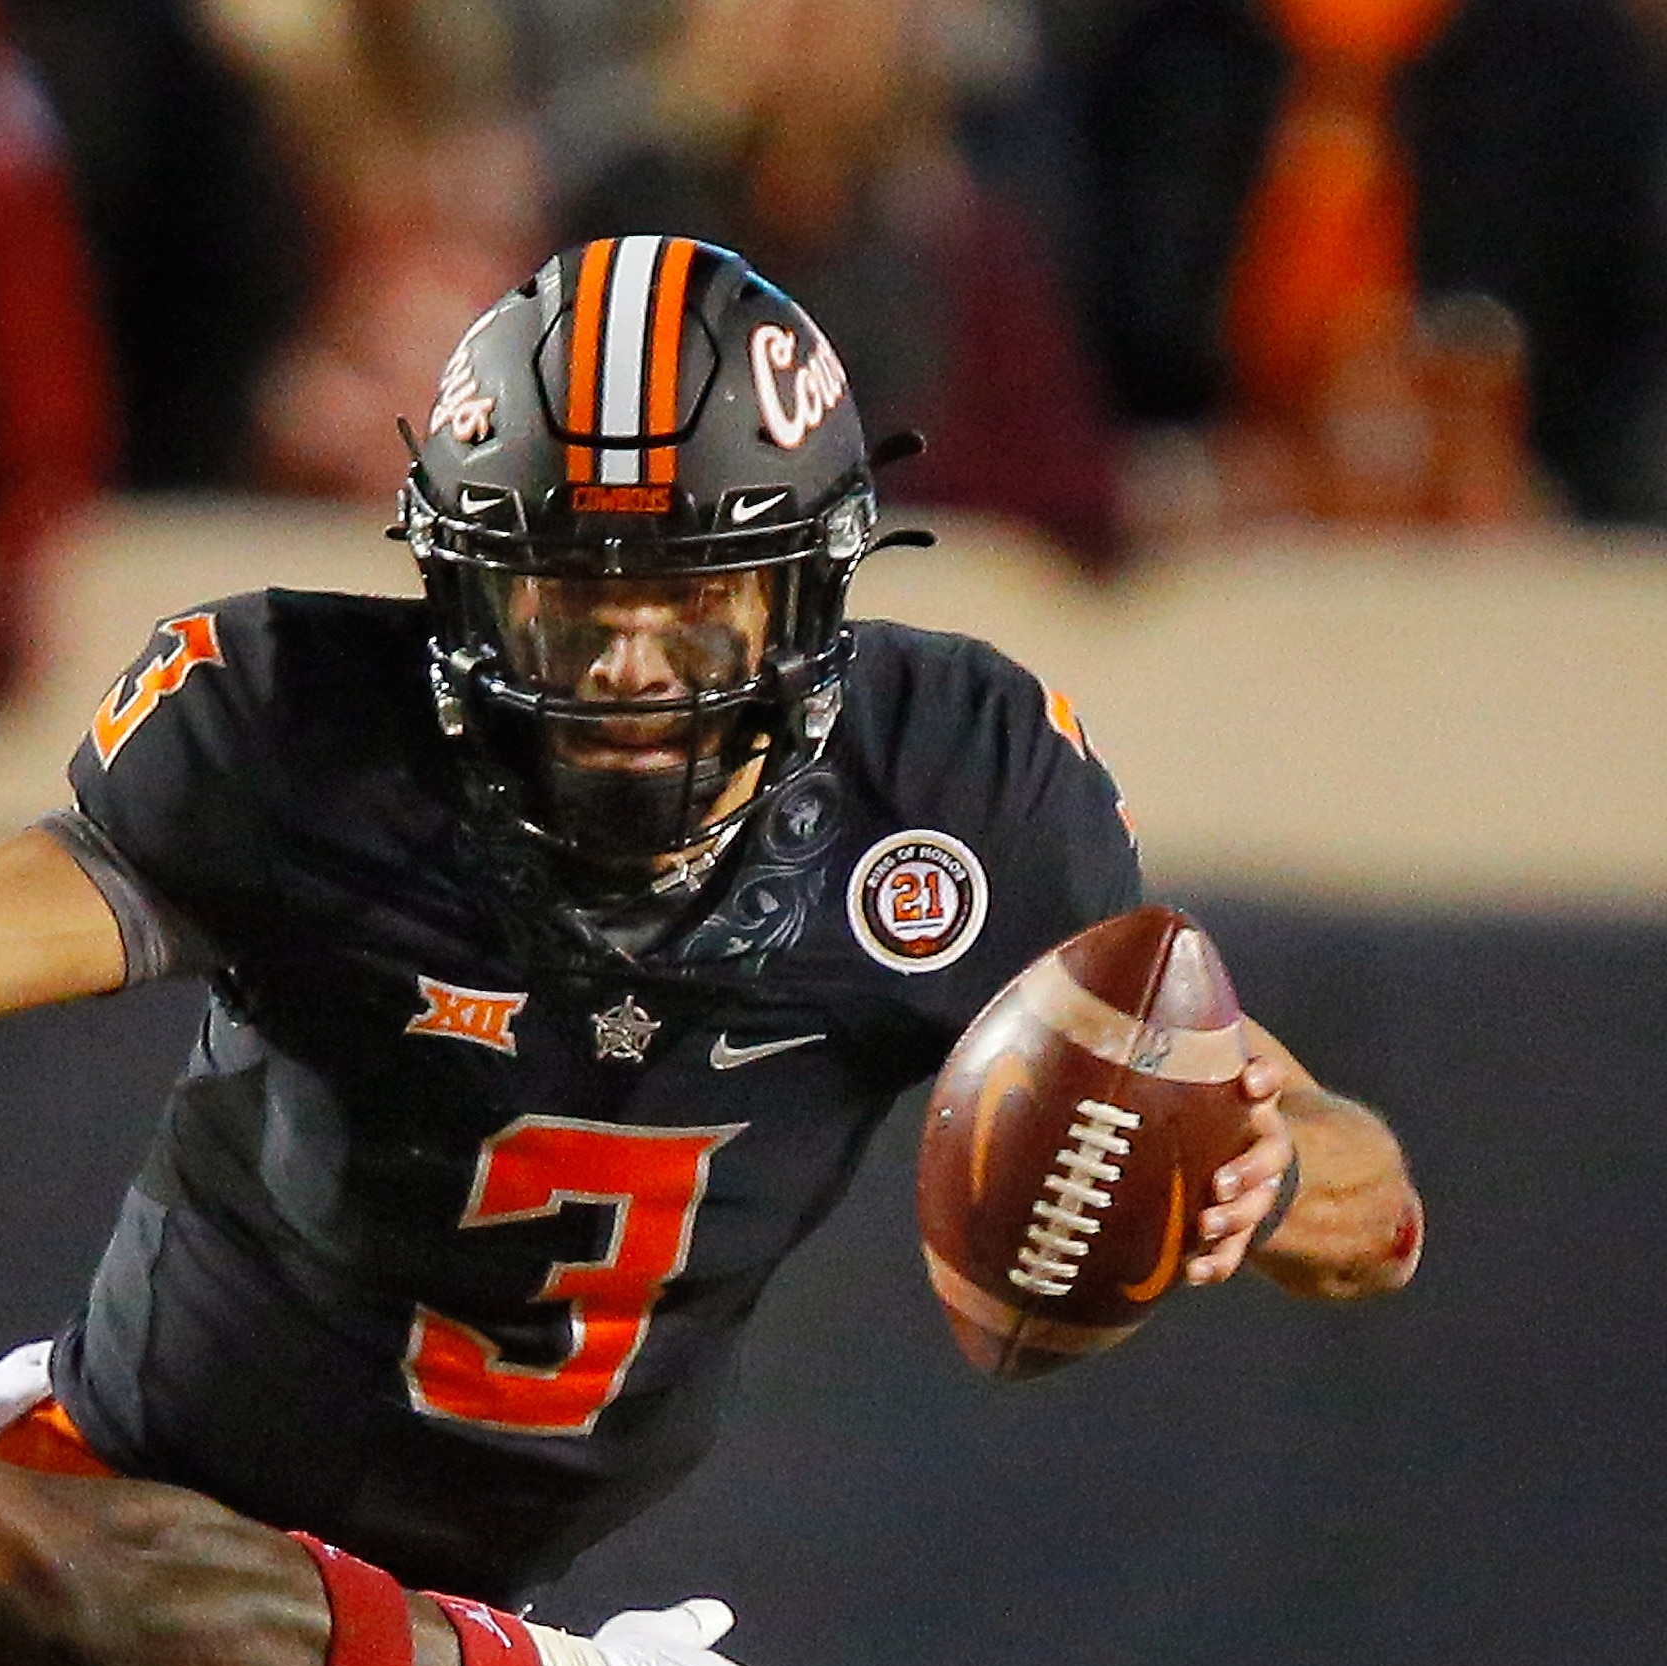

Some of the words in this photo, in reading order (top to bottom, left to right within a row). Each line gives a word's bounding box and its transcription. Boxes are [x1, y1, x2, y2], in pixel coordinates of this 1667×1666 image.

[92, 612, 227, 772] 3
[867, 855, 897, 888] RING
[897, 846, 917, 861] OF
[919, 846, 967, 882] HONOR
[892, 871, 944, 922] 21
[405, 975, 528, 1057] XII
[399, 1113, 751, 1437] 3
